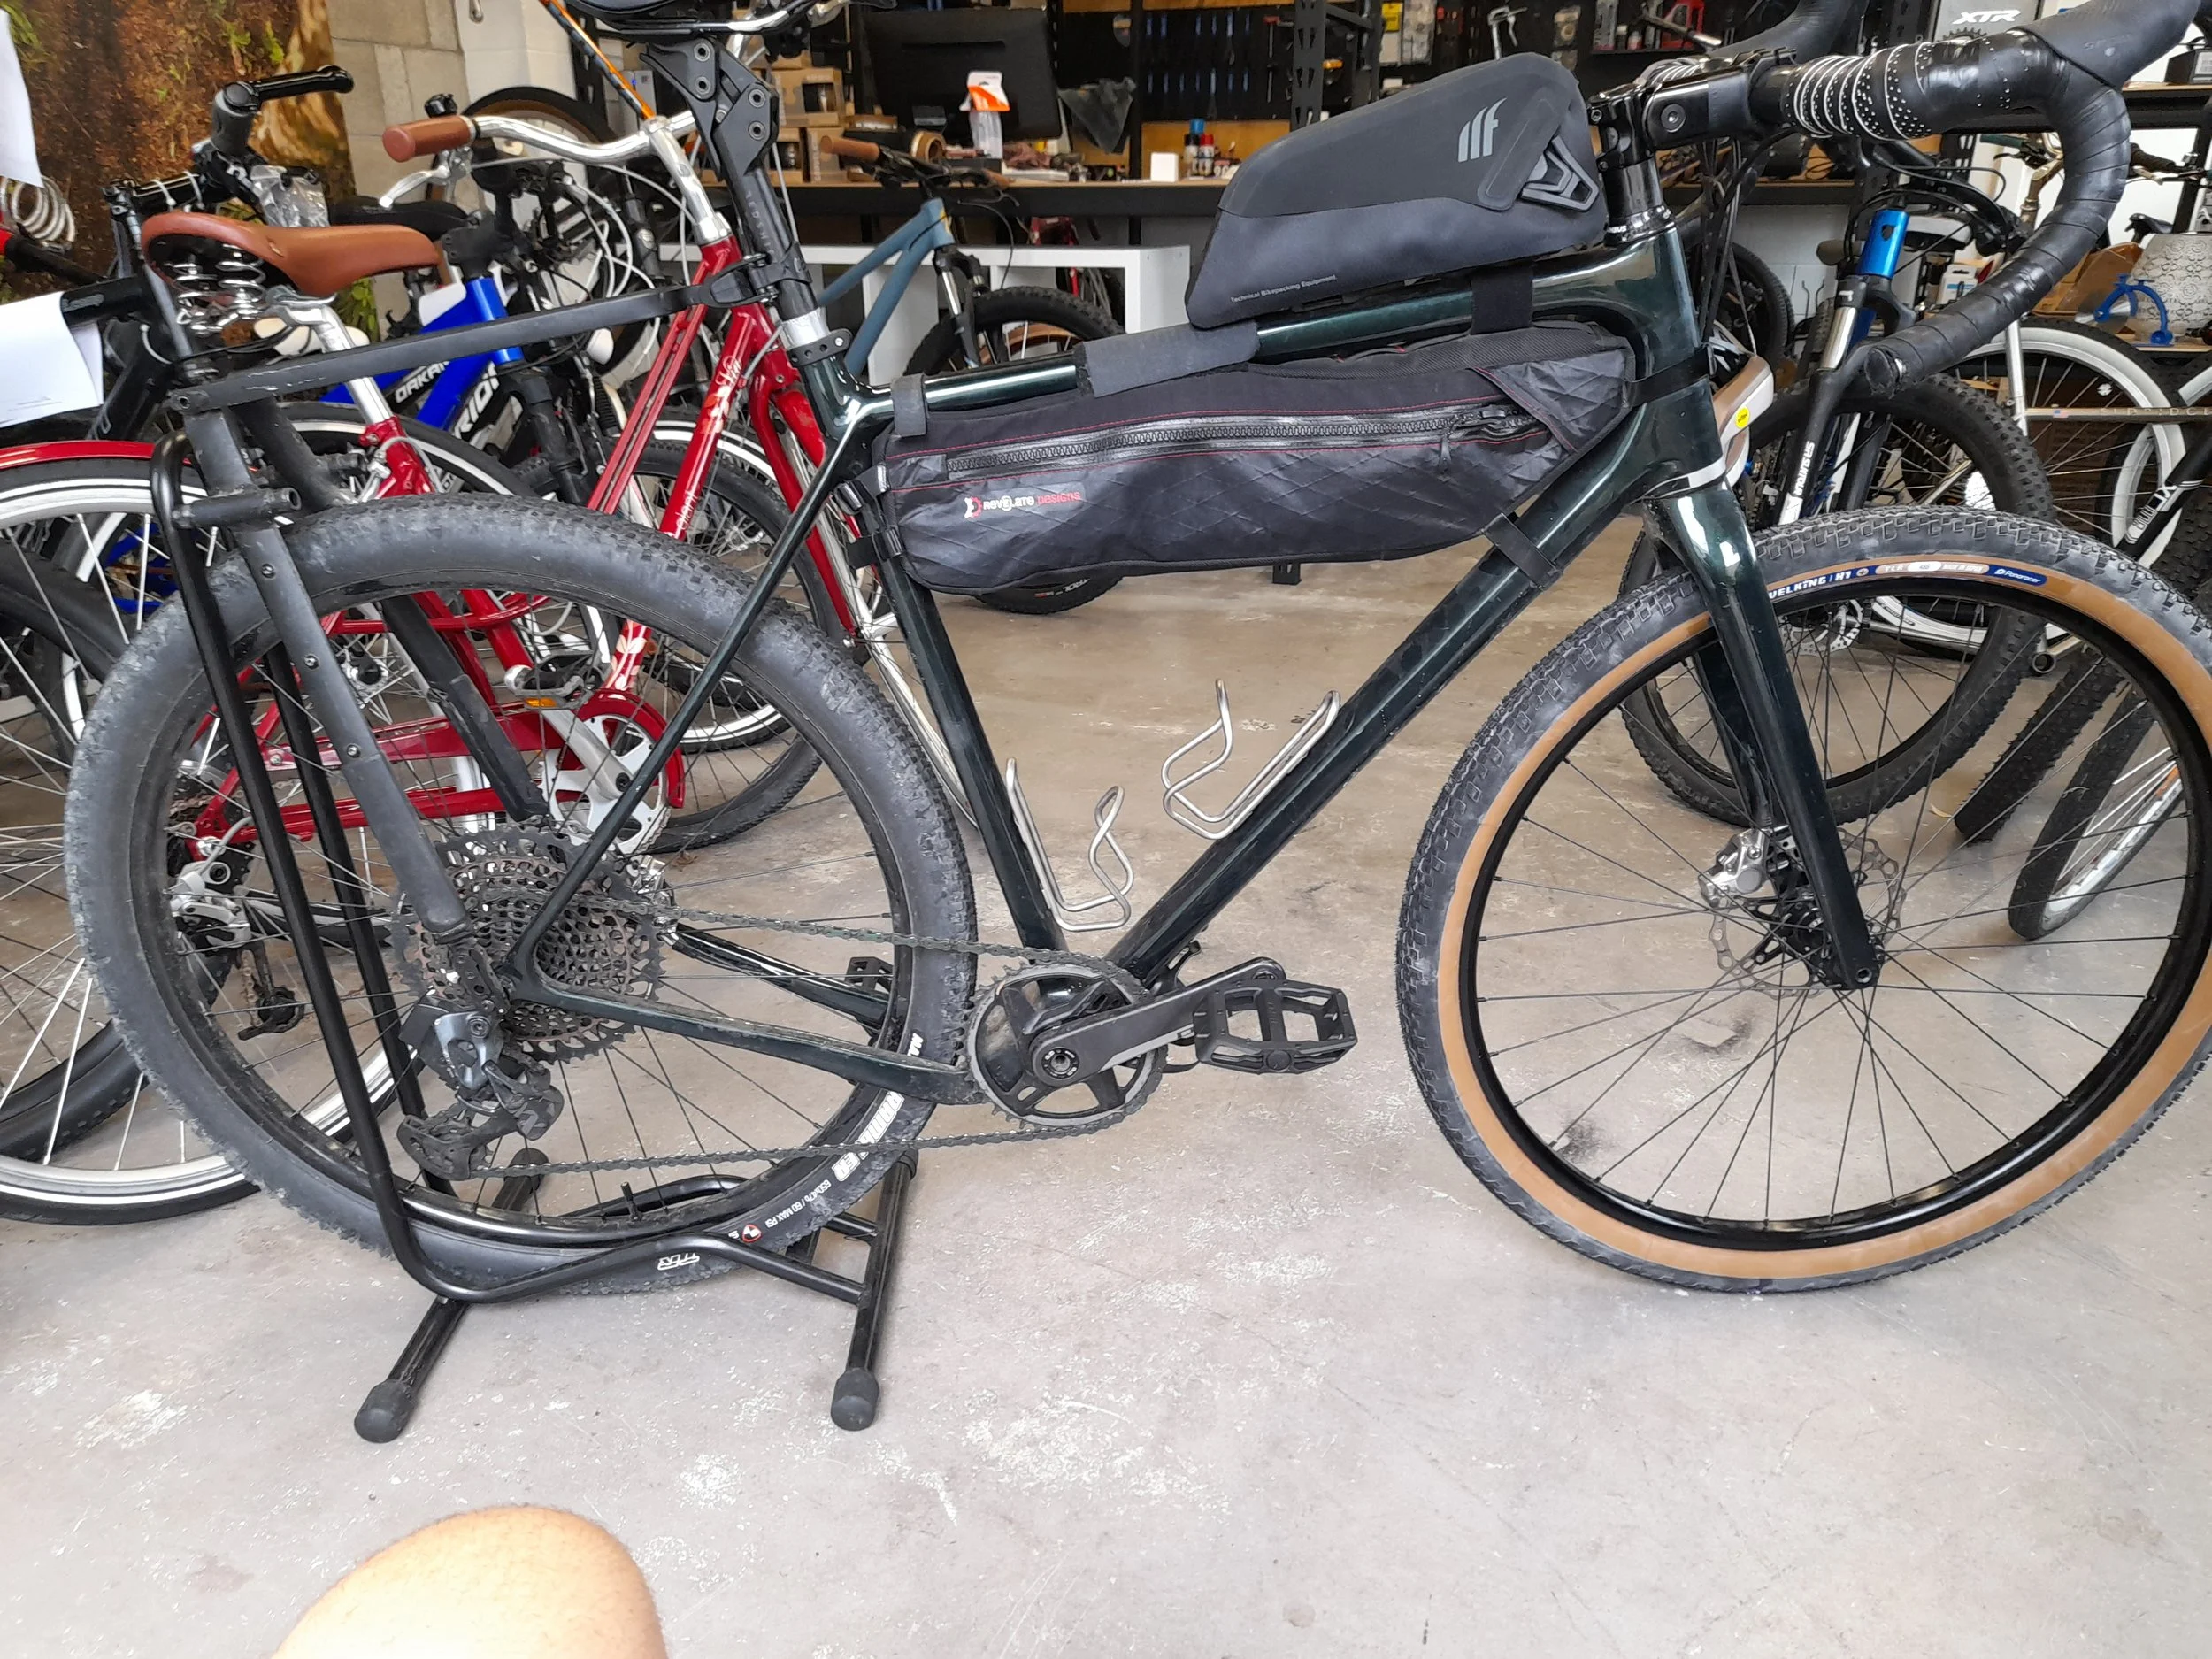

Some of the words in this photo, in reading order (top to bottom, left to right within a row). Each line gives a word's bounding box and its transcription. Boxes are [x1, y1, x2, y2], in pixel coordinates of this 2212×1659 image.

[1952, 10, 2021, 25] XTR
[746, 191, 775, 254] REDSHIF
[1230, 291, 1261, 303] Technical
[1260, 282, 1302, 297] Bikepacking
[1301, 274, 1337, 288] Equipment
[1793, 457, 1811, 496] SUNTOUR
[2004, 570, 2041, 584] Panaracer
[832, 1090, 904, 1182] RAMBER
[764, 1217, 780, 1229] PSI
[774, 1206, 795, 1223] MAX
